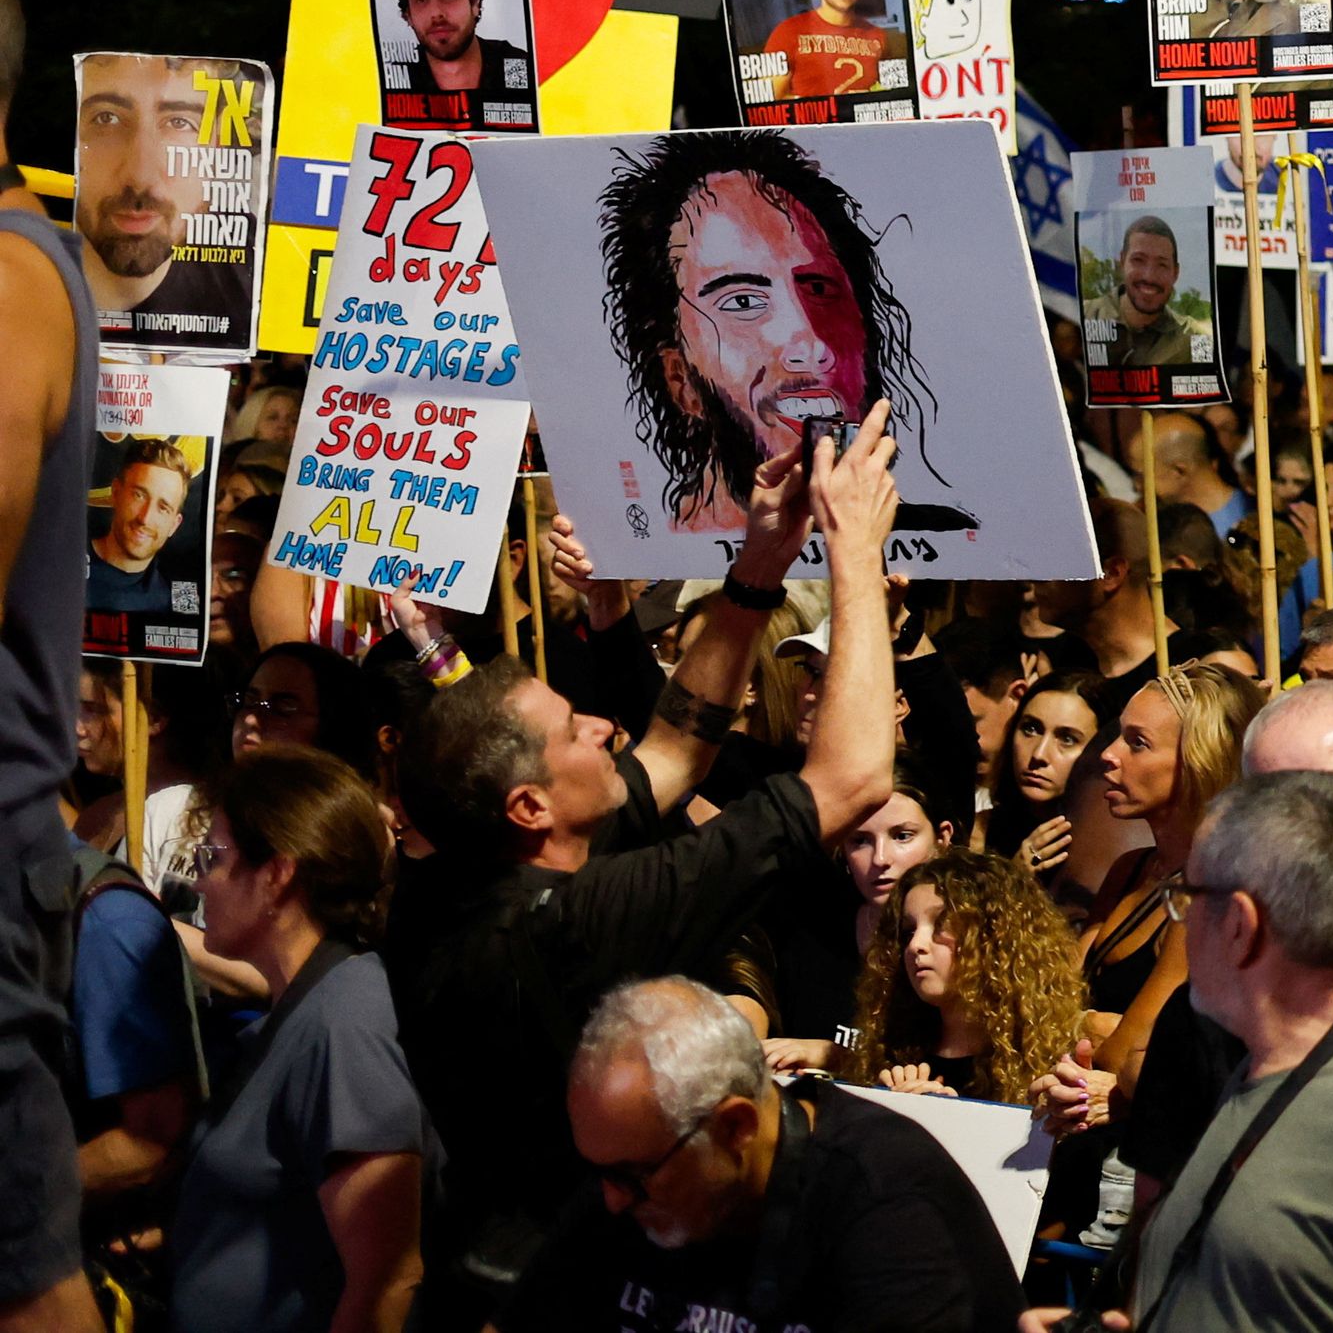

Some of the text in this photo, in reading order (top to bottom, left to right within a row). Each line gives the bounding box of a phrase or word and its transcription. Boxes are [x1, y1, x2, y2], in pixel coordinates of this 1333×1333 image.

[1158, 15, 1190, 40] HIM
[382, 39, 420, 63] BRING
[738, 51, 789, 80] BRING
[1158, 38, 1257, 68] HOME NOW!
[1273, 53, 1333, 67] FAMILIES FORUM
[385, 64, 411, 89] HIM
[742, 79, 774, 104] HIM
[193, 70, 255, 147] אל
[386, 93, 428, 118] HOME
[747, 96, 838, 125] HOME NOW!
[1252, 93, 1296, 119] NOW!
[166, 145, 252, 180] תשאירו
[202, 181, 250, 213] אותי
[181, 213, 249, 247] מאחור
[369, 233, 486, 307] days
[335, 297, 499, 334] Save our
[1084, 318, 1118, 342] BRING
[314, 331, 520, 386] HOSTAGES
[1087, 343, 1108, 366] HIM
[140, 391, 152, 407] OR
[316, 385, 476, 428] Save our
[315, 415, 477, 471] SOULS
[297, 455, 479, 515] BRING THEM
[309, 496, 419, 553] ALL
[275, 531, 465, 599] HOME NOW!
